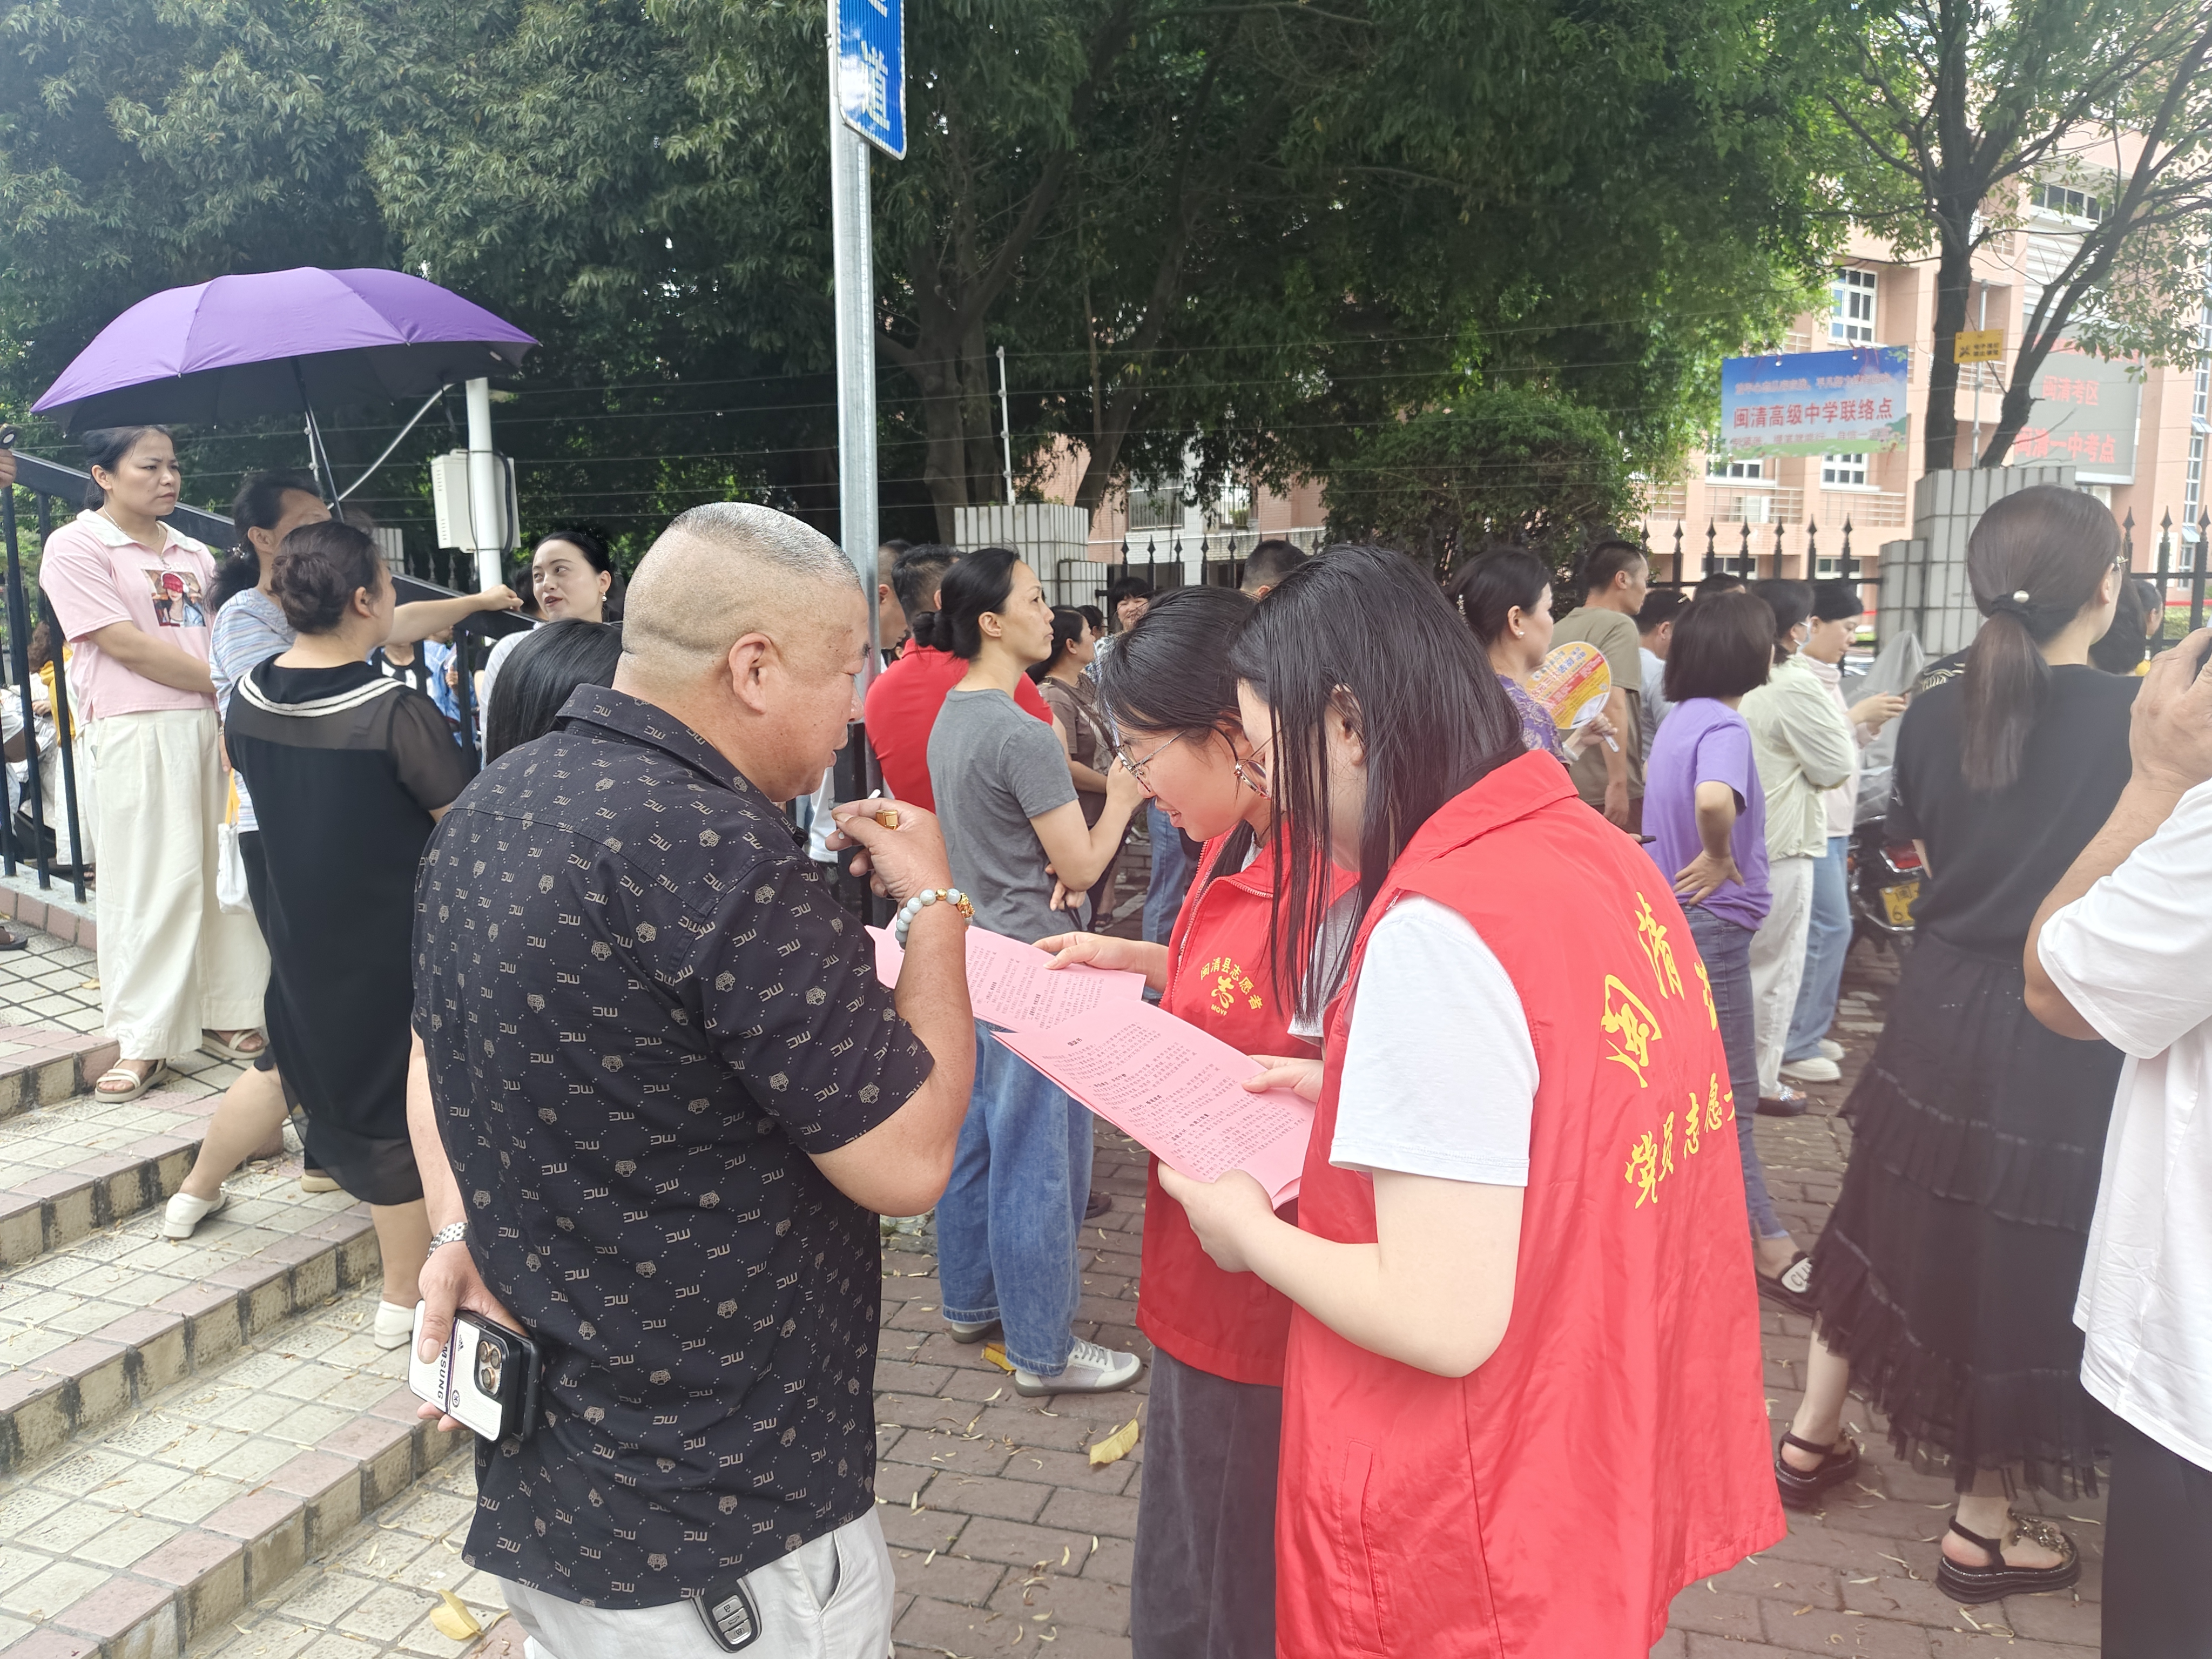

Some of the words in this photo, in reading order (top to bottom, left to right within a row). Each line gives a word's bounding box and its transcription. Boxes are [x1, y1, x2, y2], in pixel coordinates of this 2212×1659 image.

[861, 0, 890, 131] 道
[2042, 375, 2100, 405] 闽清考区
[1734, 397, 1893, 429] 闽清高级中学联络点
[2014, 427, 2115, 463] 闽清一中考点
[1201, 957, 1263, 1009] 闽清县志愿者
[437, 1340, 448, 1400] MSUNG
